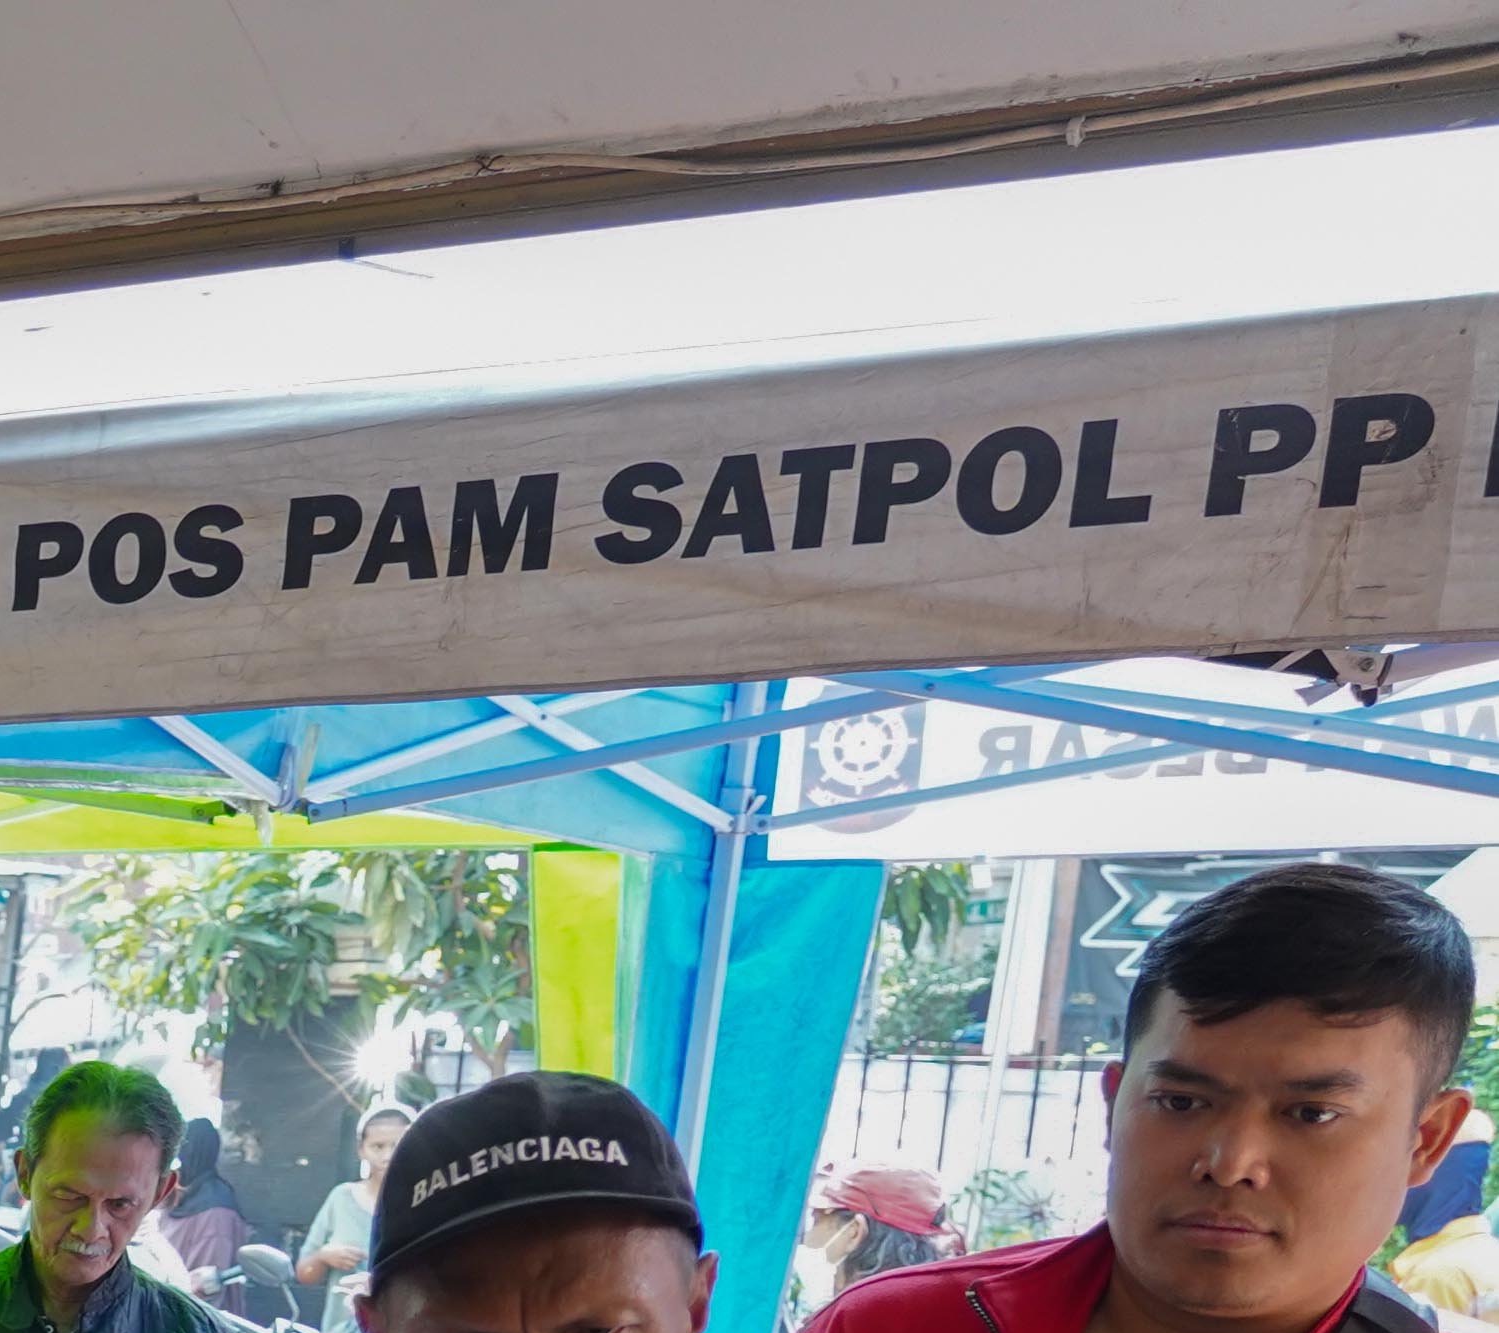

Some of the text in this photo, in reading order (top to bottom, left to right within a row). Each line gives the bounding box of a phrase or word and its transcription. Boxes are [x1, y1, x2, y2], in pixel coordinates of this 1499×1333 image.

[12, 393, 1436, 611] POS PAM SATPOL PP
[410, 1134, 629, 1208] BALENCIAGA
